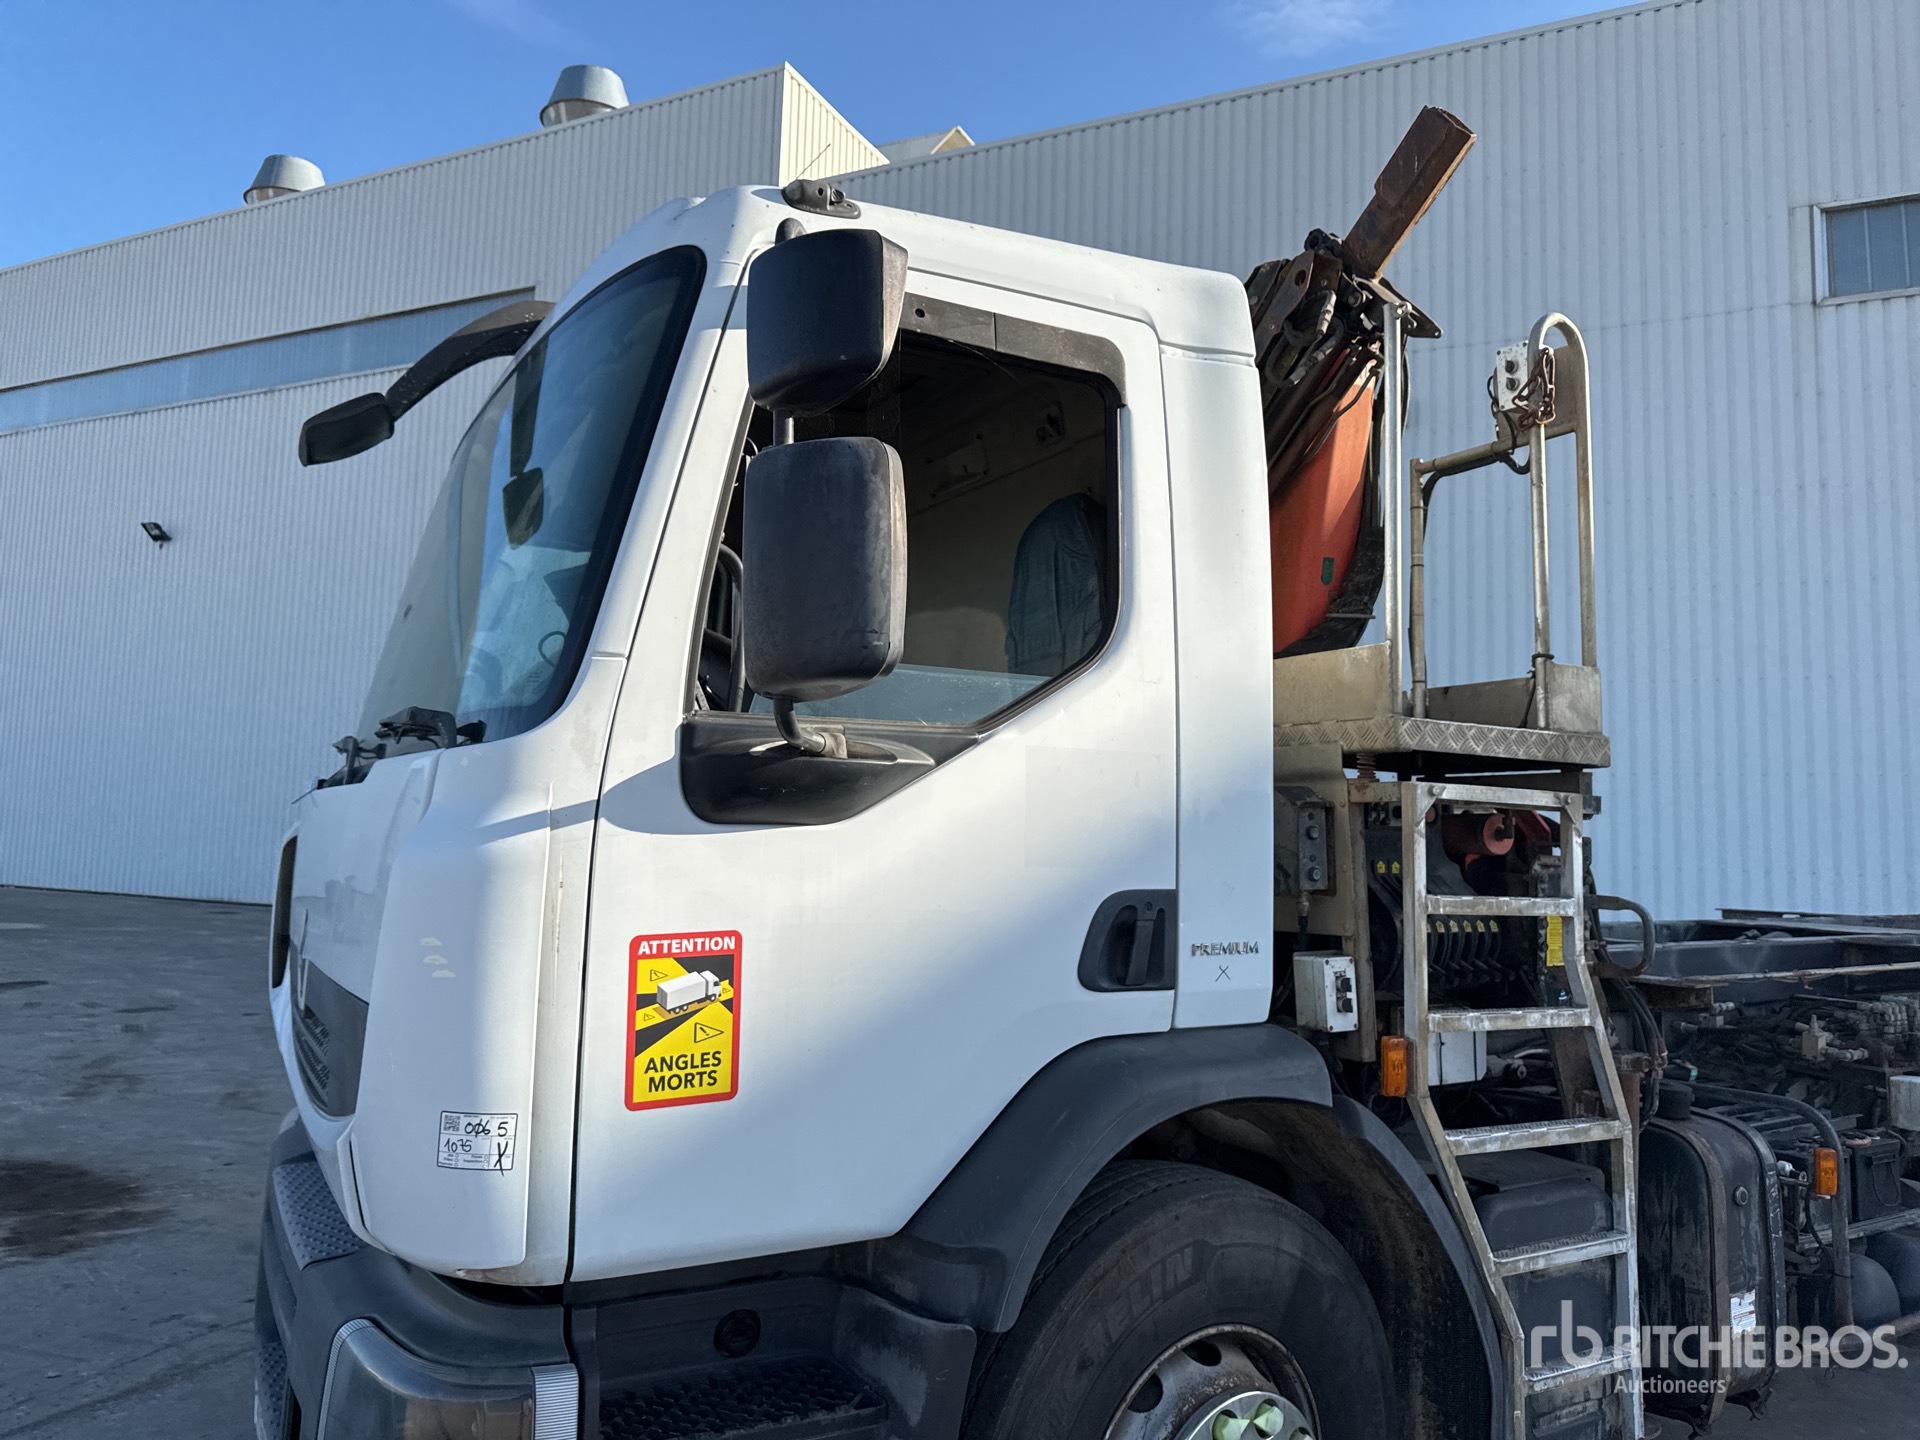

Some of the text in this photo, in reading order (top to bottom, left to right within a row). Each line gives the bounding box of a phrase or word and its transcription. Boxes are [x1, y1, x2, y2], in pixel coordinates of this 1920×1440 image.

[637, 935, 736, 956] ATTENTION
[1191, 941, 1259, 956] PREMIUM
[644, 1050, 722, 1074] ANGLES
[648, 1070, 718, 1093] MORTS
